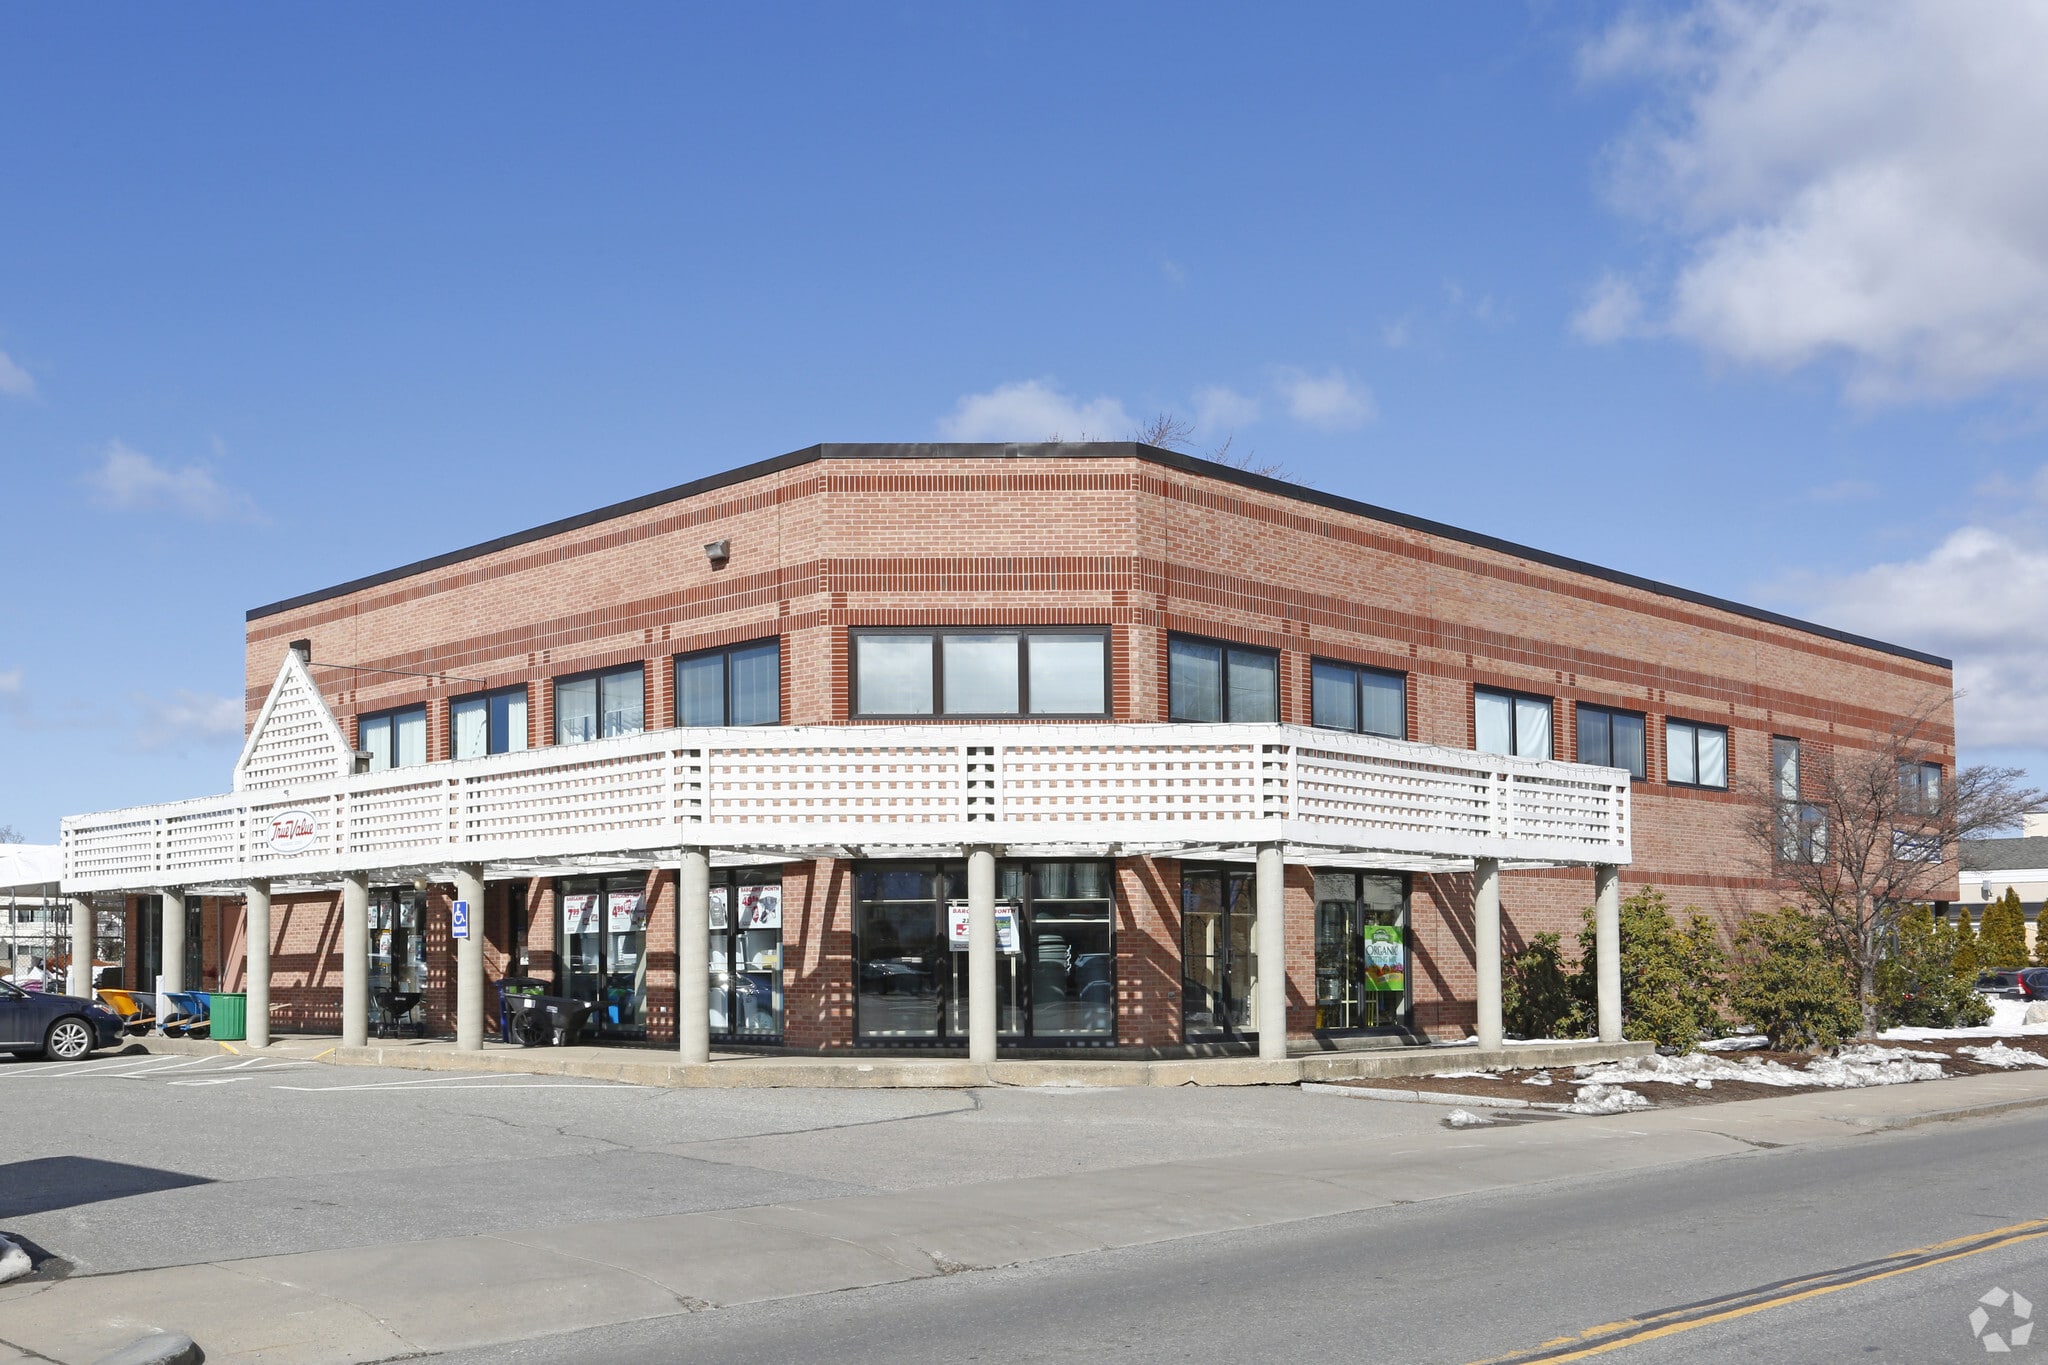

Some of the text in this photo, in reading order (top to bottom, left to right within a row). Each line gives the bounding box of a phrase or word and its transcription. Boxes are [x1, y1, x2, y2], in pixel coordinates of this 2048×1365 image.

[271, 818, 314, 842] True Value
[1366, 944, 1399, 956] ORGANIC
